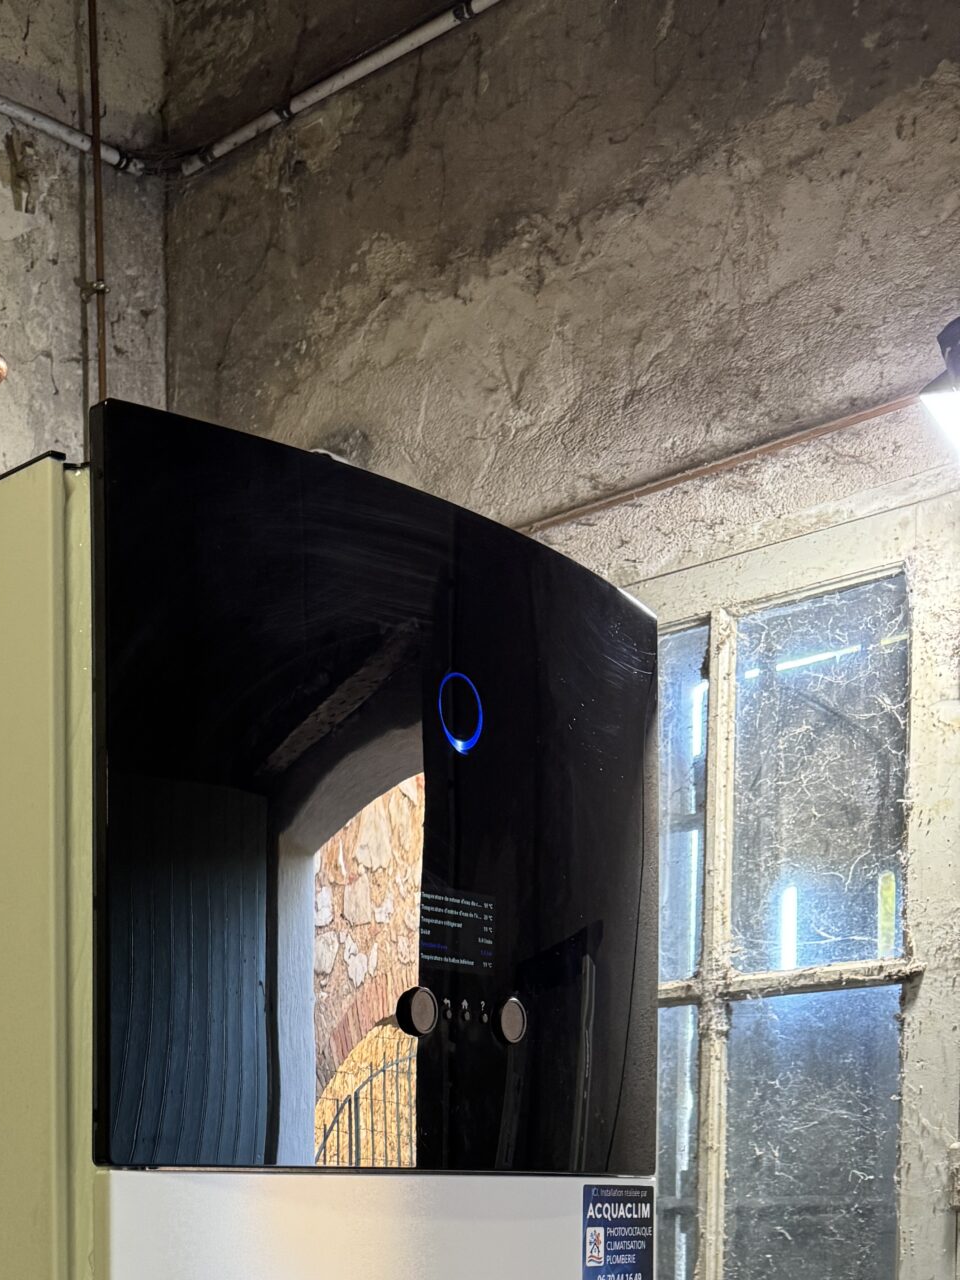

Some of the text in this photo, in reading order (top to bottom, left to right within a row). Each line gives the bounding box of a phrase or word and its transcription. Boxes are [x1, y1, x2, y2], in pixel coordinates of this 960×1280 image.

[600, 1188, 623, 1197] Installation
[587, 1202, 650, 1221] ACQUACLIM
[606, 1240, 646, 1250] CLIMATISATION
[606, 1254, 636, 1264] PLOMBERIE
